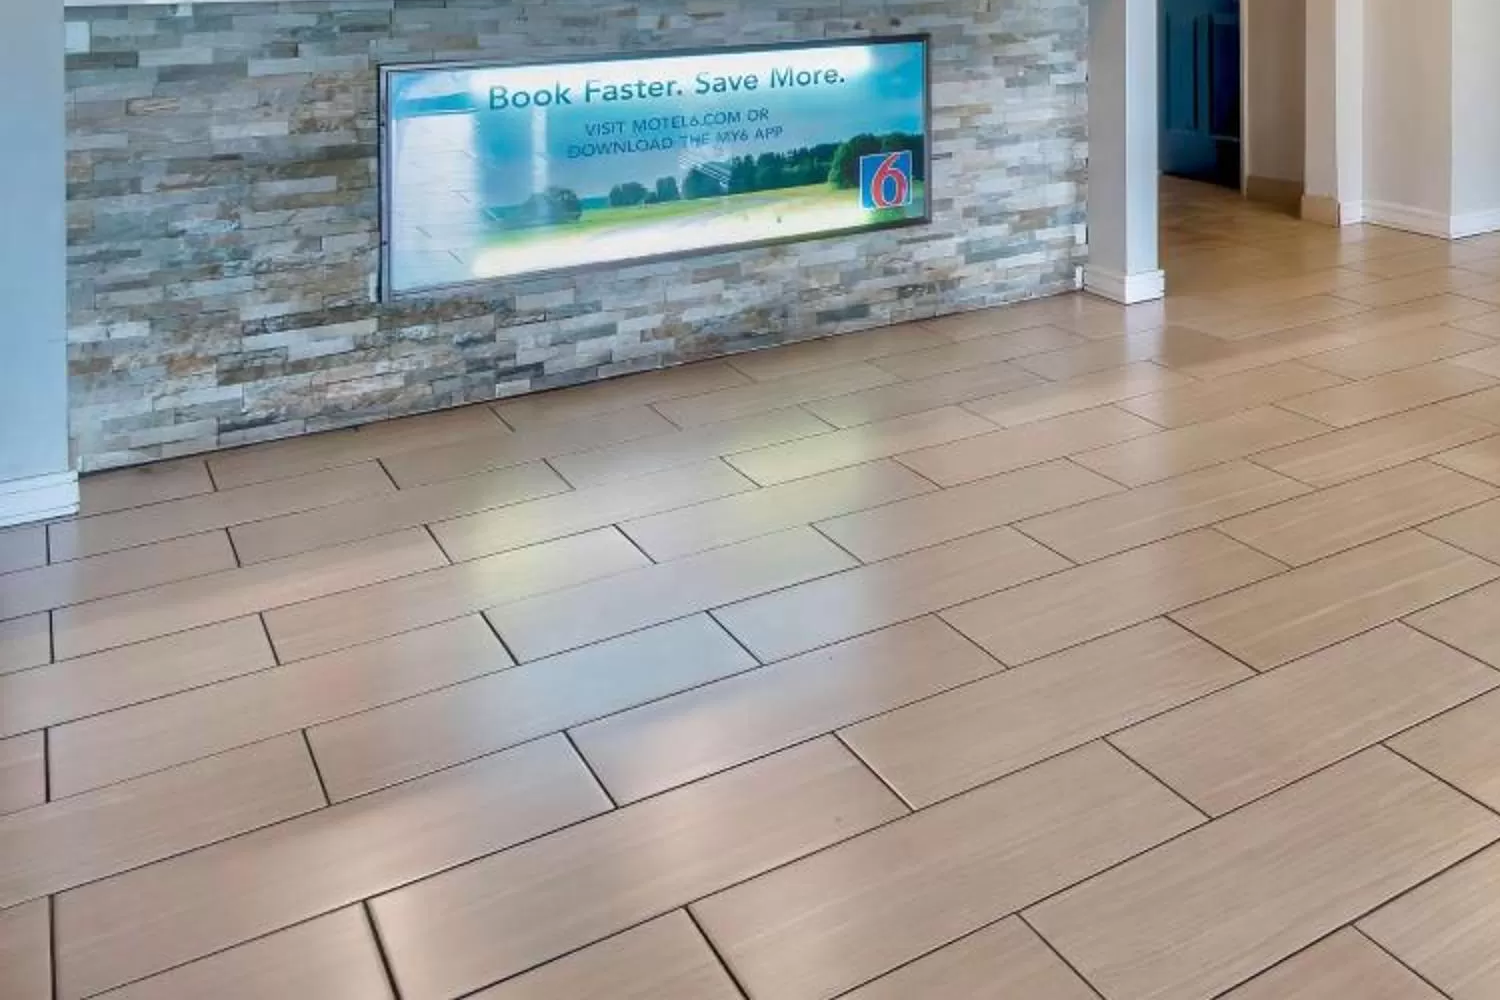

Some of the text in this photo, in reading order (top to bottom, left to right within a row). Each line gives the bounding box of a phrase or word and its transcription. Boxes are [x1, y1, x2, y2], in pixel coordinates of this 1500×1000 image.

[489, 67, 845, 110] Book Faster. Save More.
[585, 107, 769, 137] VISIT MOTEL6.COM OR
[567, 125, 783, 159] DOWNLOAD THE MY6 APP
[871, 151, 908, 209] 6
